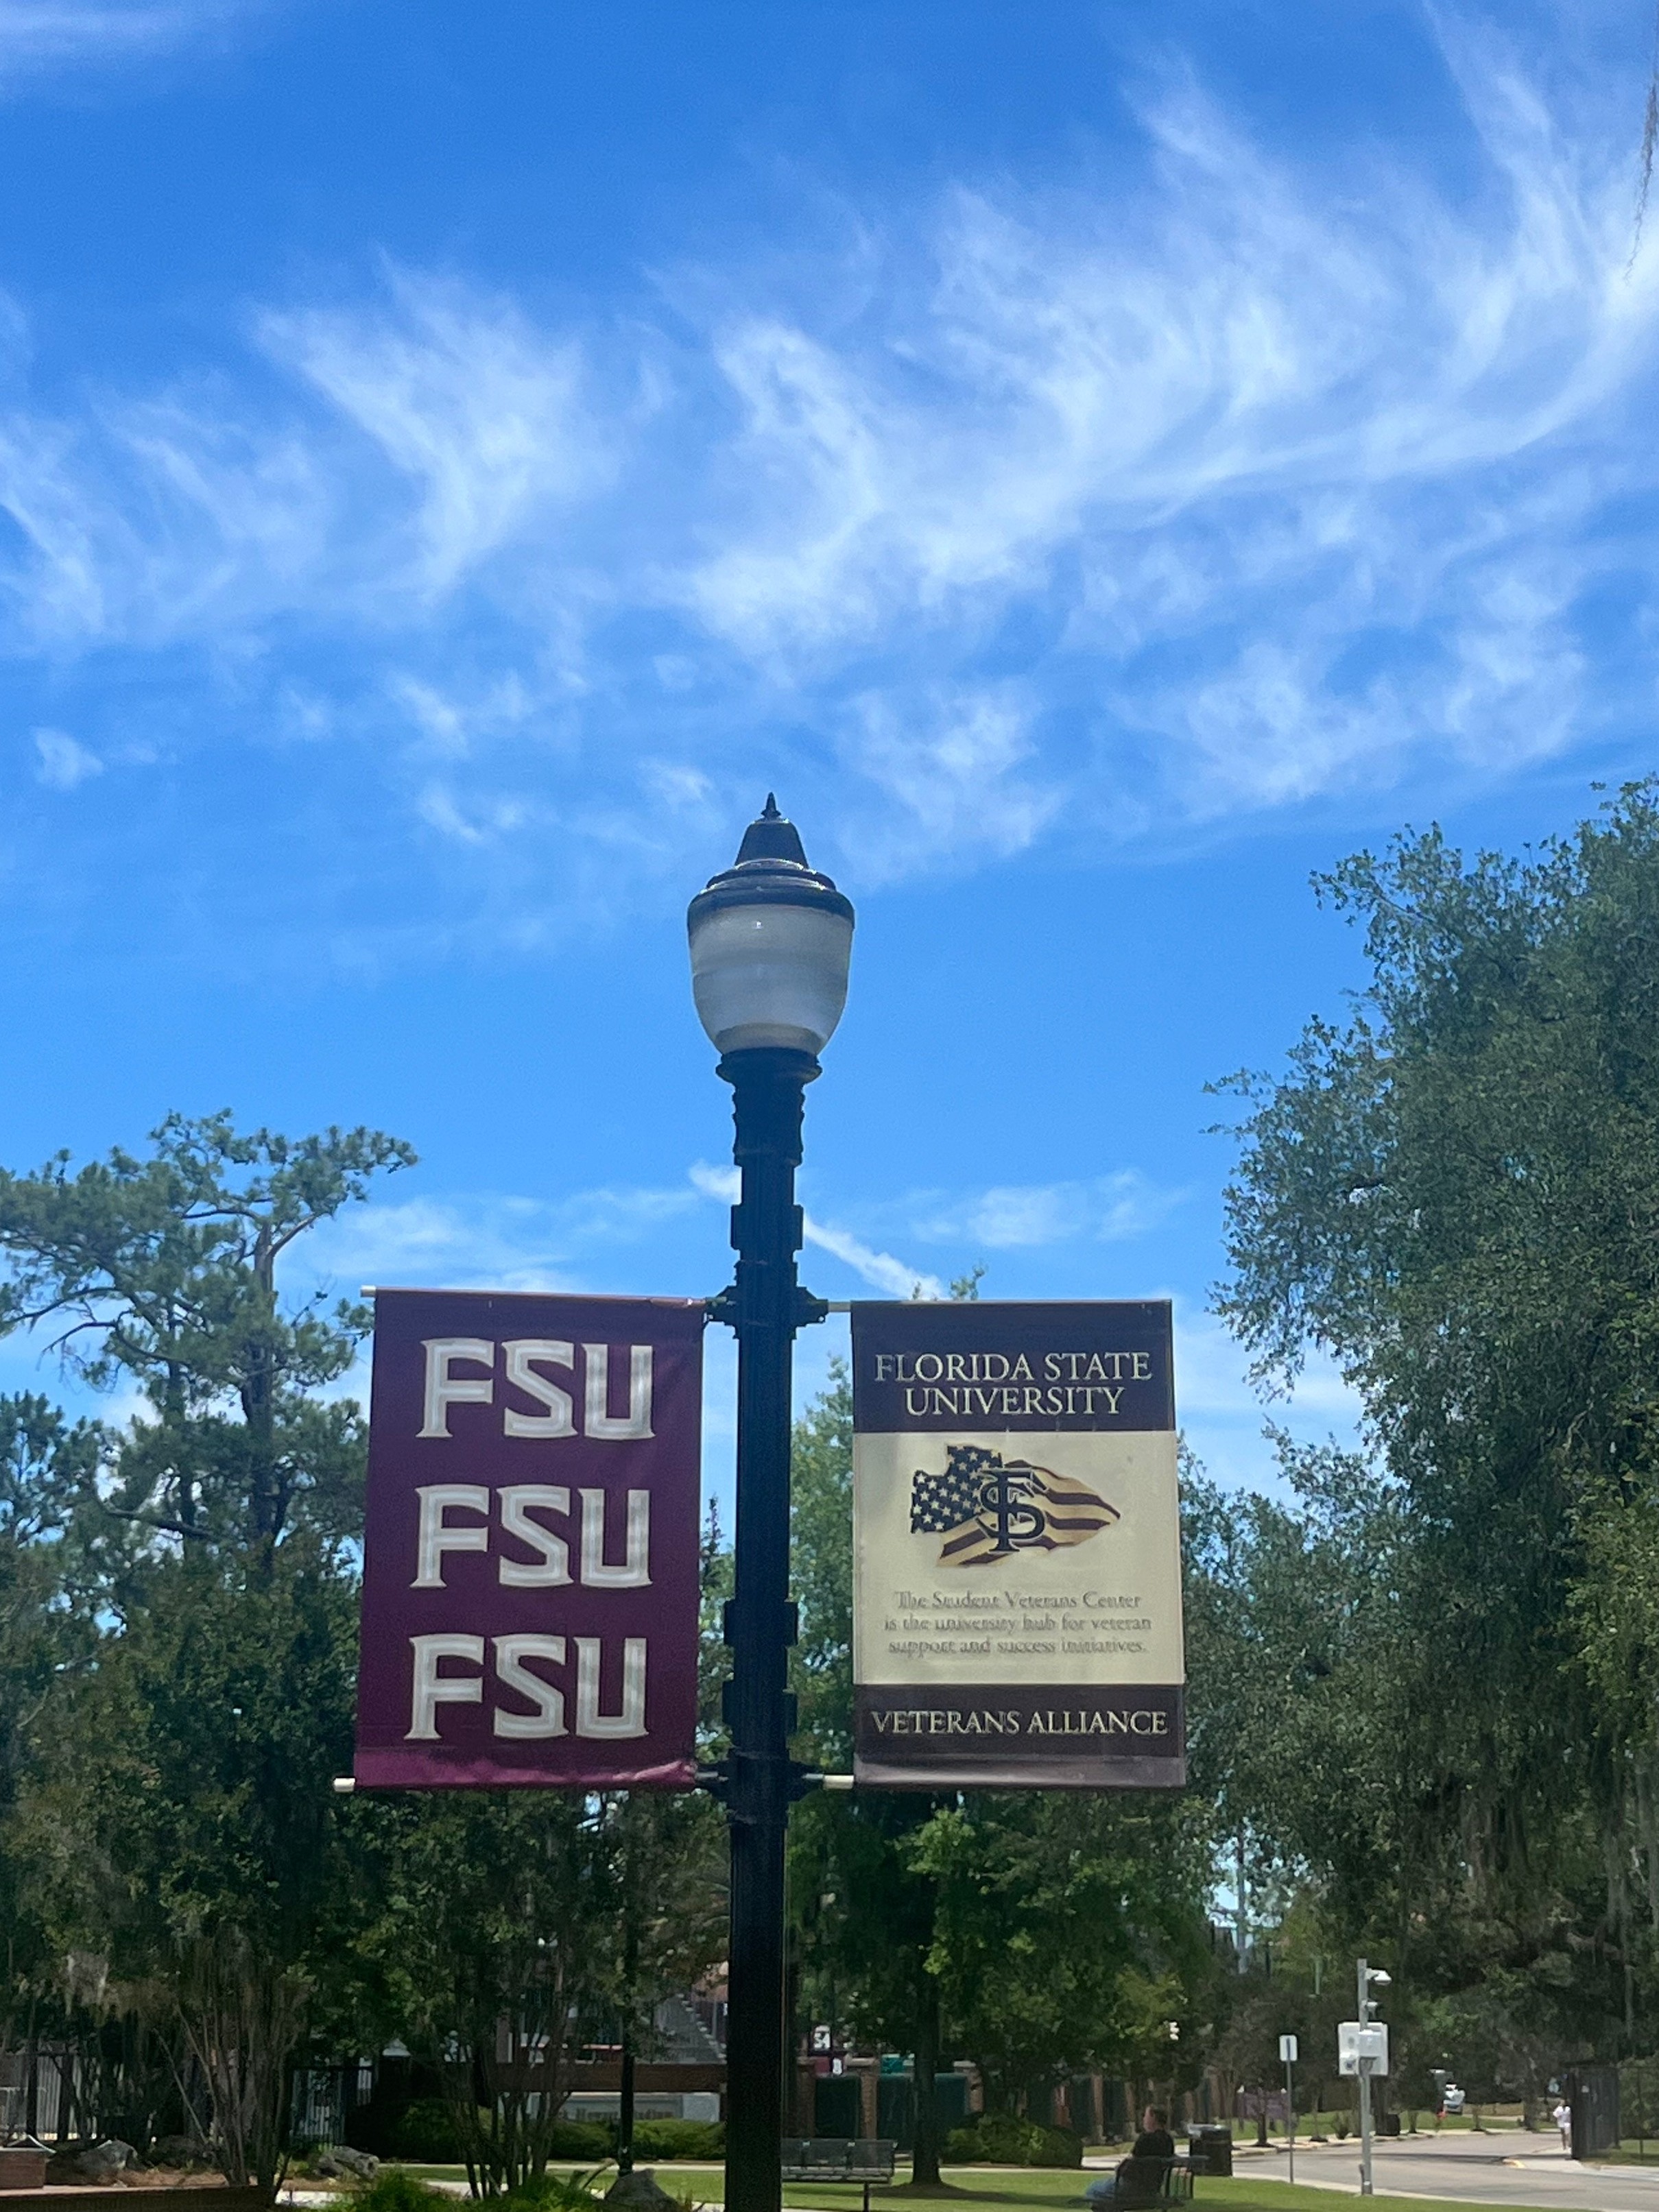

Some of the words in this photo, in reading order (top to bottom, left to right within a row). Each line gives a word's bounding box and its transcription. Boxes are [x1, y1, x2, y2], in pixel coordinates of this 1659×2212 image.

[874, 1352, 1034, 1382] FLORIDA
[1044, 1352, 1153, 1381] STATE
[415, 1338, 656, 1441] FSU
[905, 1386, 1125, 1416] UNIVERSITY
[409, 1484, 653, 1588] FSU
[894, 1591, 927, 1609] The
[931, 1590, 1000, 1609] Student
[1004, 1591, 1077, 1609] Veterans
[1082, 1591, 1141, 1609] Center
[884, 1615, 897, 1631] is
[903, 1613, 929, 1631] the
[935, 1615, 1016, 1635] university
[1023, 1613, 1056, 1631] hub
[1062, 1612, 1086, 1631] for
[1091, 1618, 1152, 1631] veteran
[889, 1641, 957, 1658] support
[960, 1635, 991, 1653] and
[998, 1640, 1056, 1653] success
[1062, 1637, 1147, 1653] initiatives.
[403, 1633, 649, 1740] FSU
[870, 1710, 1021, 1734] VETERANS
[1028, 1710, 1168, 1735] ALLIANCE
